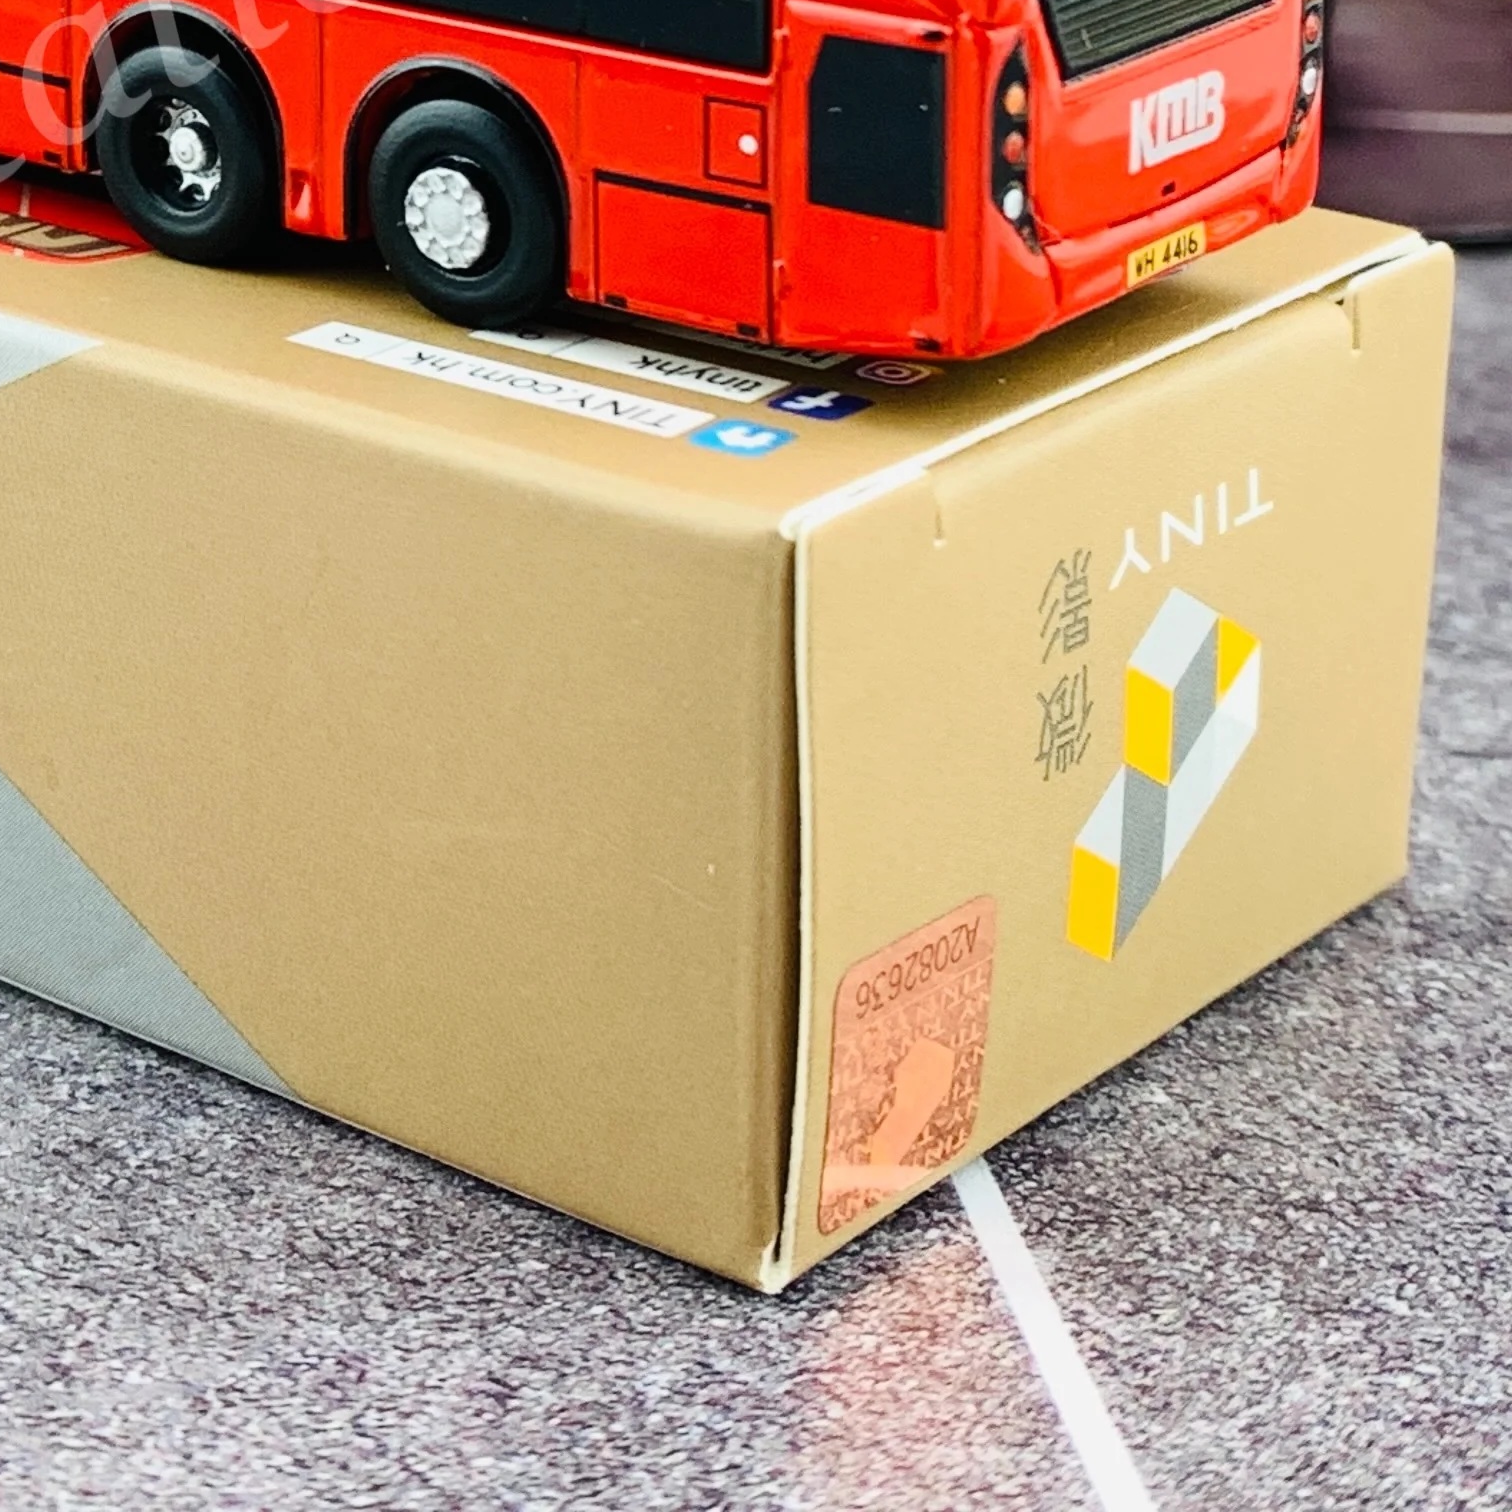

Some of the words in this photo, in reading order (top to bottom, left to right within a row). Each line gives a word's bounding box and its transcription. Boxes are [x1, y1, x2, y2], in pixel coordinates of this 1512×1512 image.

[1163, 232, 1198, 263] 4416
[402, 350, 678, 432] TINY.com.hk
[634, 353, 764, 394] tinyhk
[1109, 467, 1275, 591] TINY
[1033, 546, 1094, 782] 微影
[854, 915, 982, 1020] A2082636
